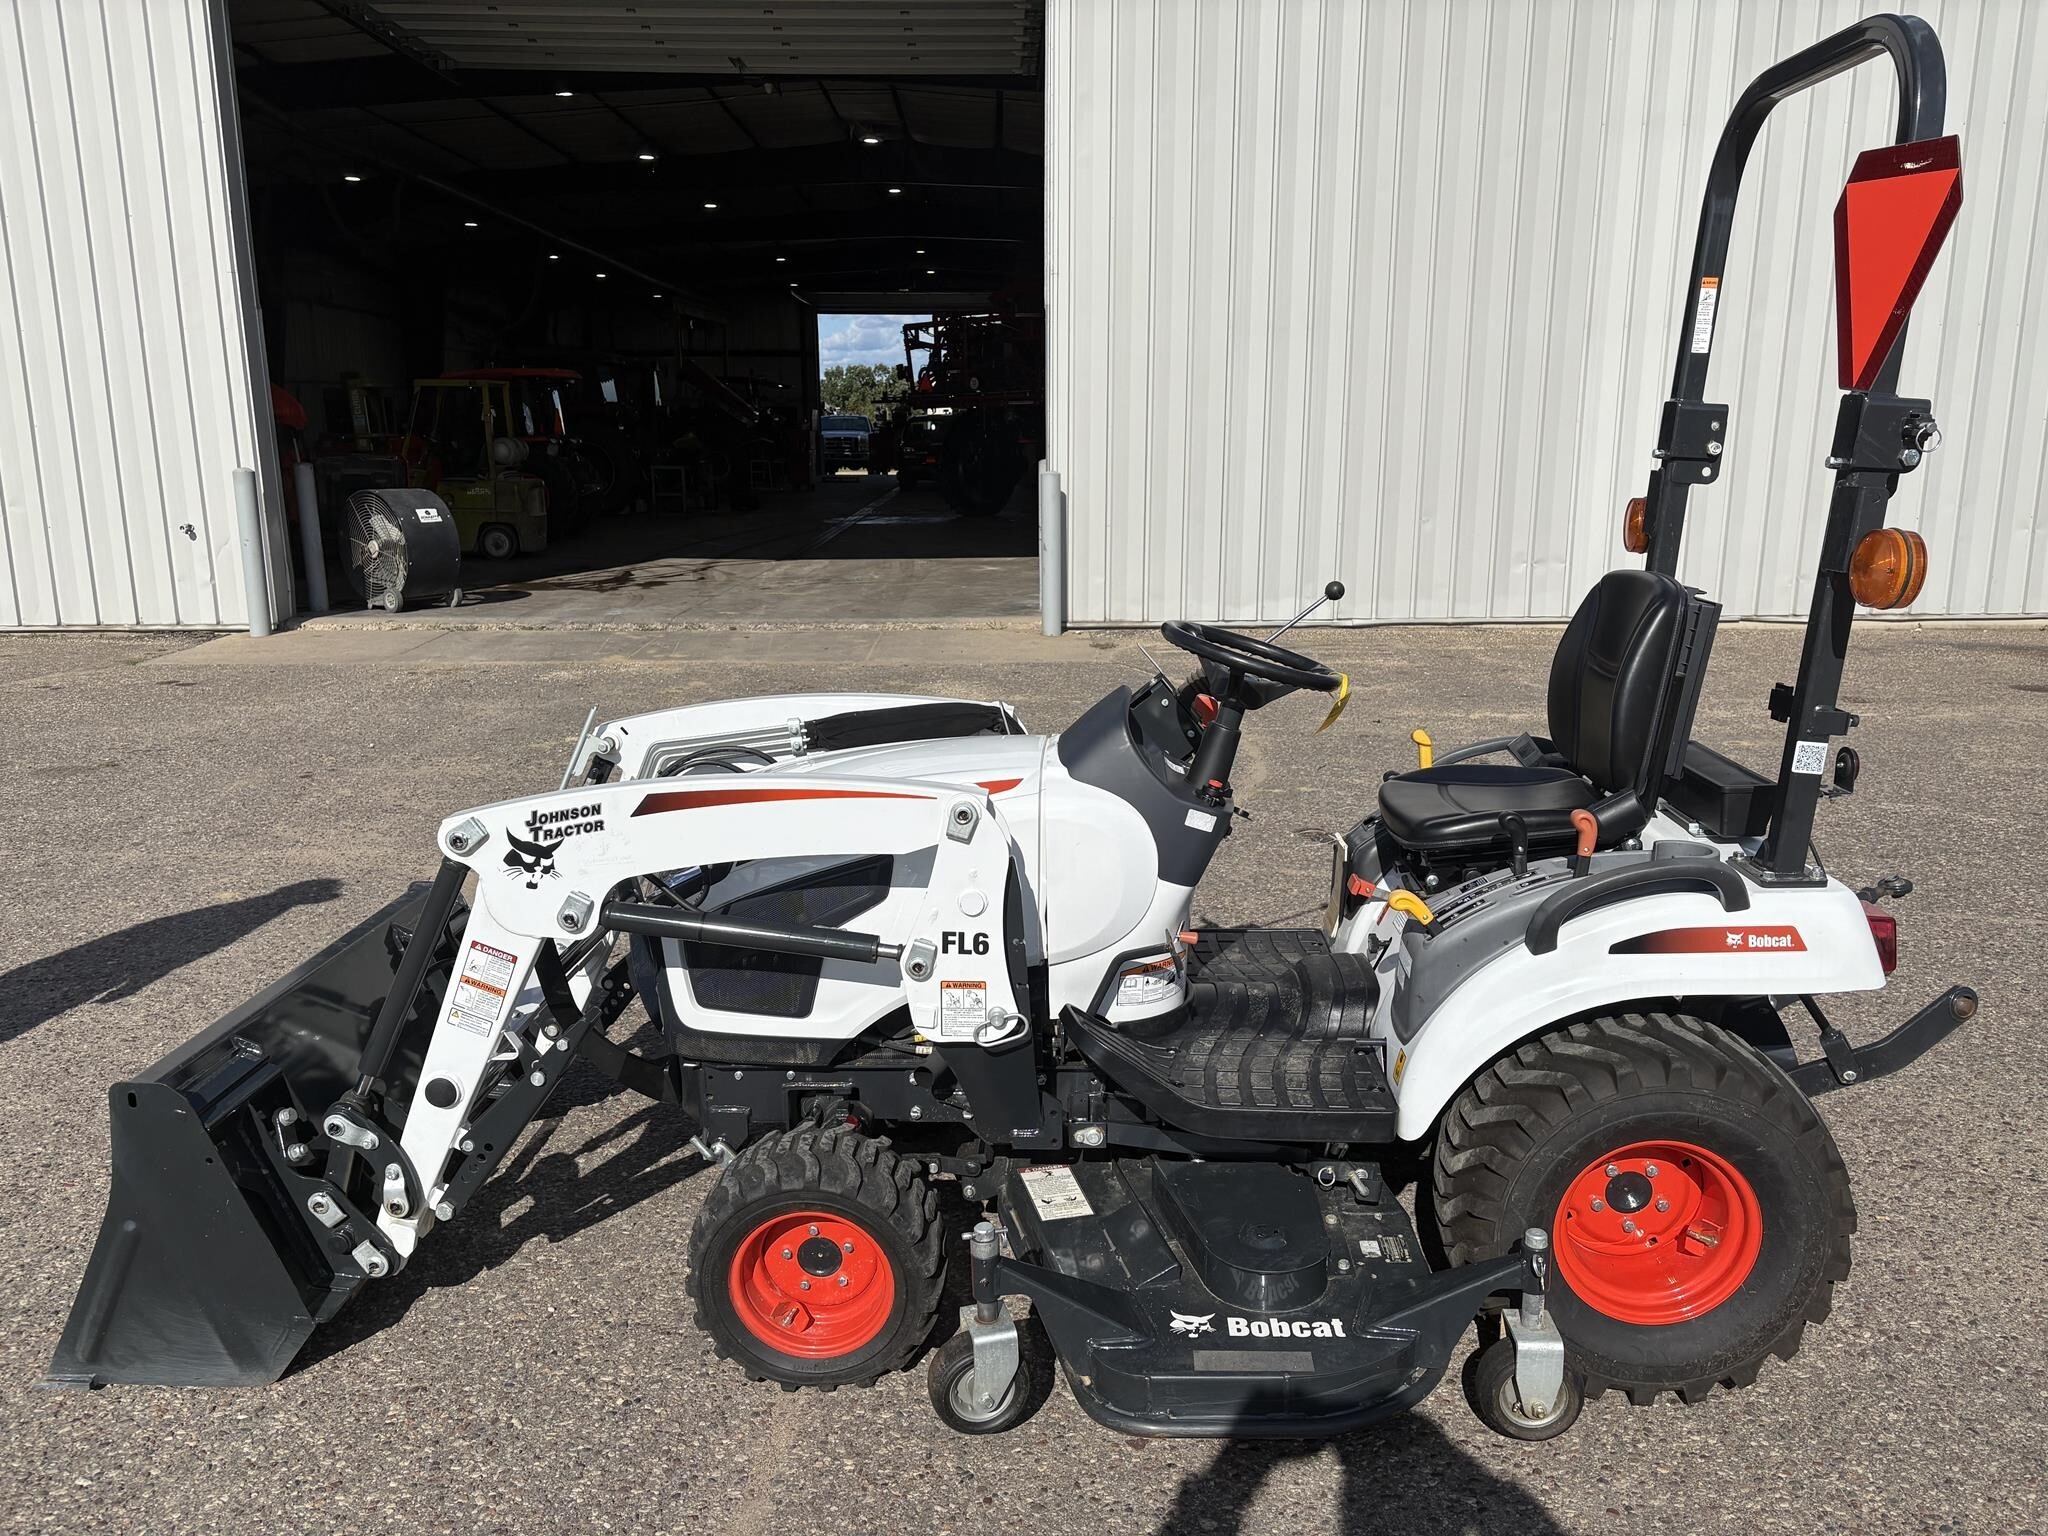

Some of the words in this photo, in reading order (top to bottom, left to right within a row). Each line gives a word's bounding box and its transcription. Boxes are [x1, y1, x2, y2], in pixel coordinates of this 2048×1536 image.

[525, 803, 602, 827] JOHNSON
[529, 820, 605, 842] TRACTOR
[942, 931, 990, 955] FL6
[1748, 934, 1792, 948] Bobcat
[482, 945, 513, 961] DANGER
[471, 979, 502, 995] WARNING
[1227, 1317, 1347, 1338] Bobcat
